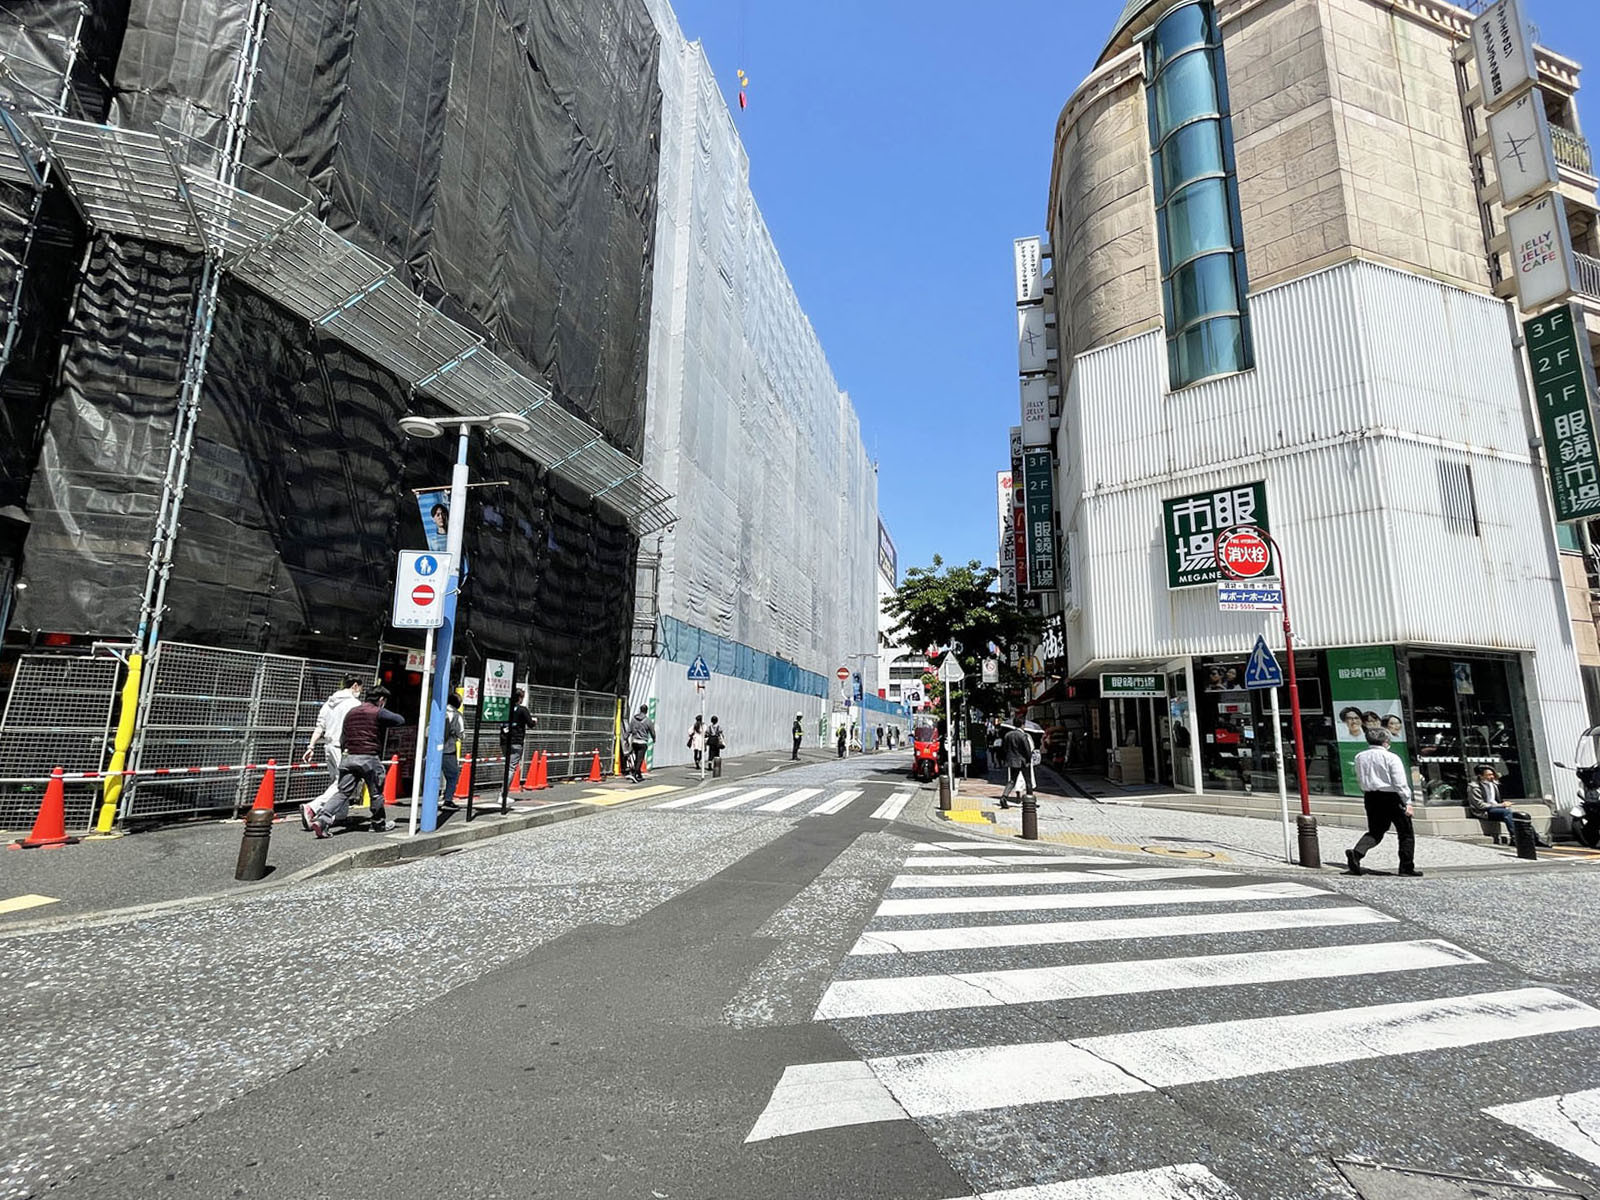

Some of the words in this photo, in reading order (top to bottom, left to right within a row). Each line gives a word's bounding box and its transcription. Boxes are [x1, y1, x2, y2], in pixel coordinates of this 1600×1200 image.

[1517, 96, 1528, 108] 5F
[1536, 200, 1548, 211] 4F
[1520, 231, 1551, 254] JELLY
[1522, 241, 1553, 264] JELLY
[1522, 251, 1555, 273] CAFE
[1026, 400, 1044, 408] JELLY
[1554, 409, 1600, 513] 眼鏡市場
[1034, 521, 1055, 587] 眼鏡市場
[1227, 545, 1265, 562] 消火栓
[1178, 571, 1222, 583] MEGANE
[1023, 599, 1035, 607] 24
[1338, 666, 1386, 679] 眼鏡市場
[1111, 676, 1155, 687] 眼鏡市場
